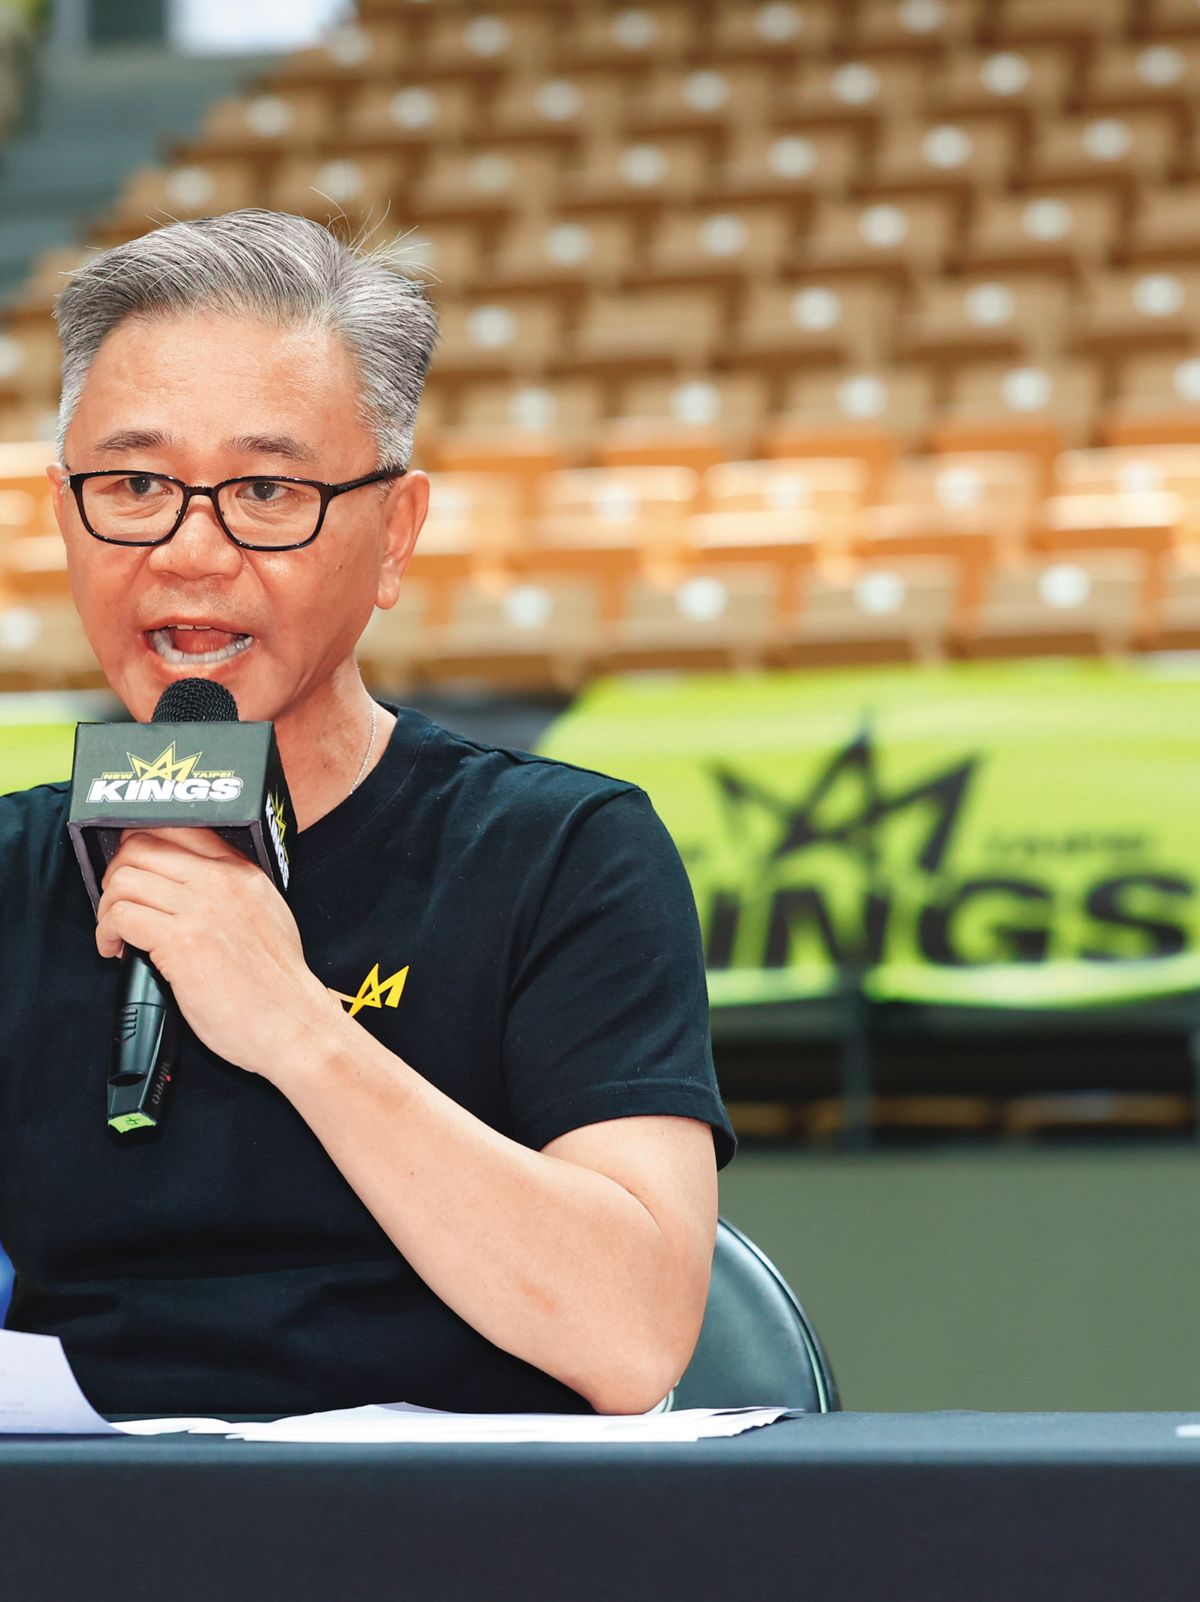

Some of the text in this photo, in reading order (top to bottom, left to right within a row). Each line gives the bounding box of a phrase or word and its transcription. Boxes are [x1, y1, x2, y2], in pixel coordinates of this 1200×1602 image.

[103, 771, 233, 780] NEW TAIPEI
[87, 778, 243, 802] KINGS
[704, 874, 1195, 968] INGS
